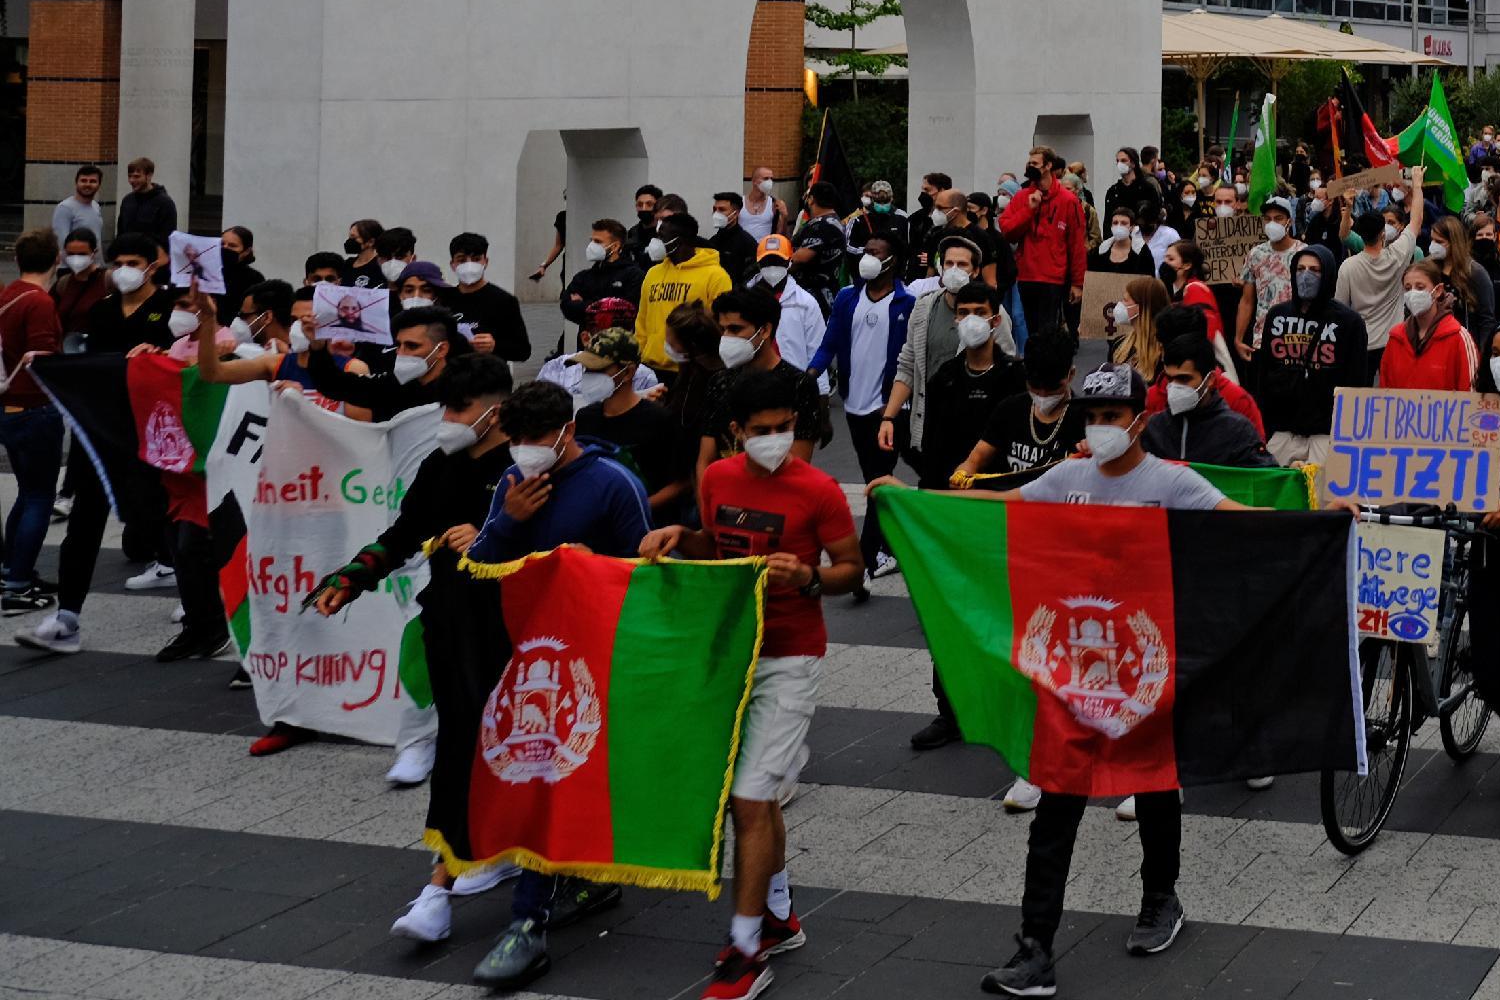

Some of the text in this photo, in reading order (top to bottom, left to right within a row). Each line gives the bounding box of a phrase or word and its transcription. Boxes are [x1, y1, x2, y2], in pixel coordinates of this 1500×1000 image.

[649, 282, 691, 303] SECURITY
[1270, 315, 1339, 342] STICK
[1334, 394, 1471, 443] LUFTBRÜCKE
[1472, 430, 1500, 443] eye
[1328, 444, 1490, 511] JETZT!
[1358, 537, 1432, 579] here
[248, 650, 289, 681] STOP
